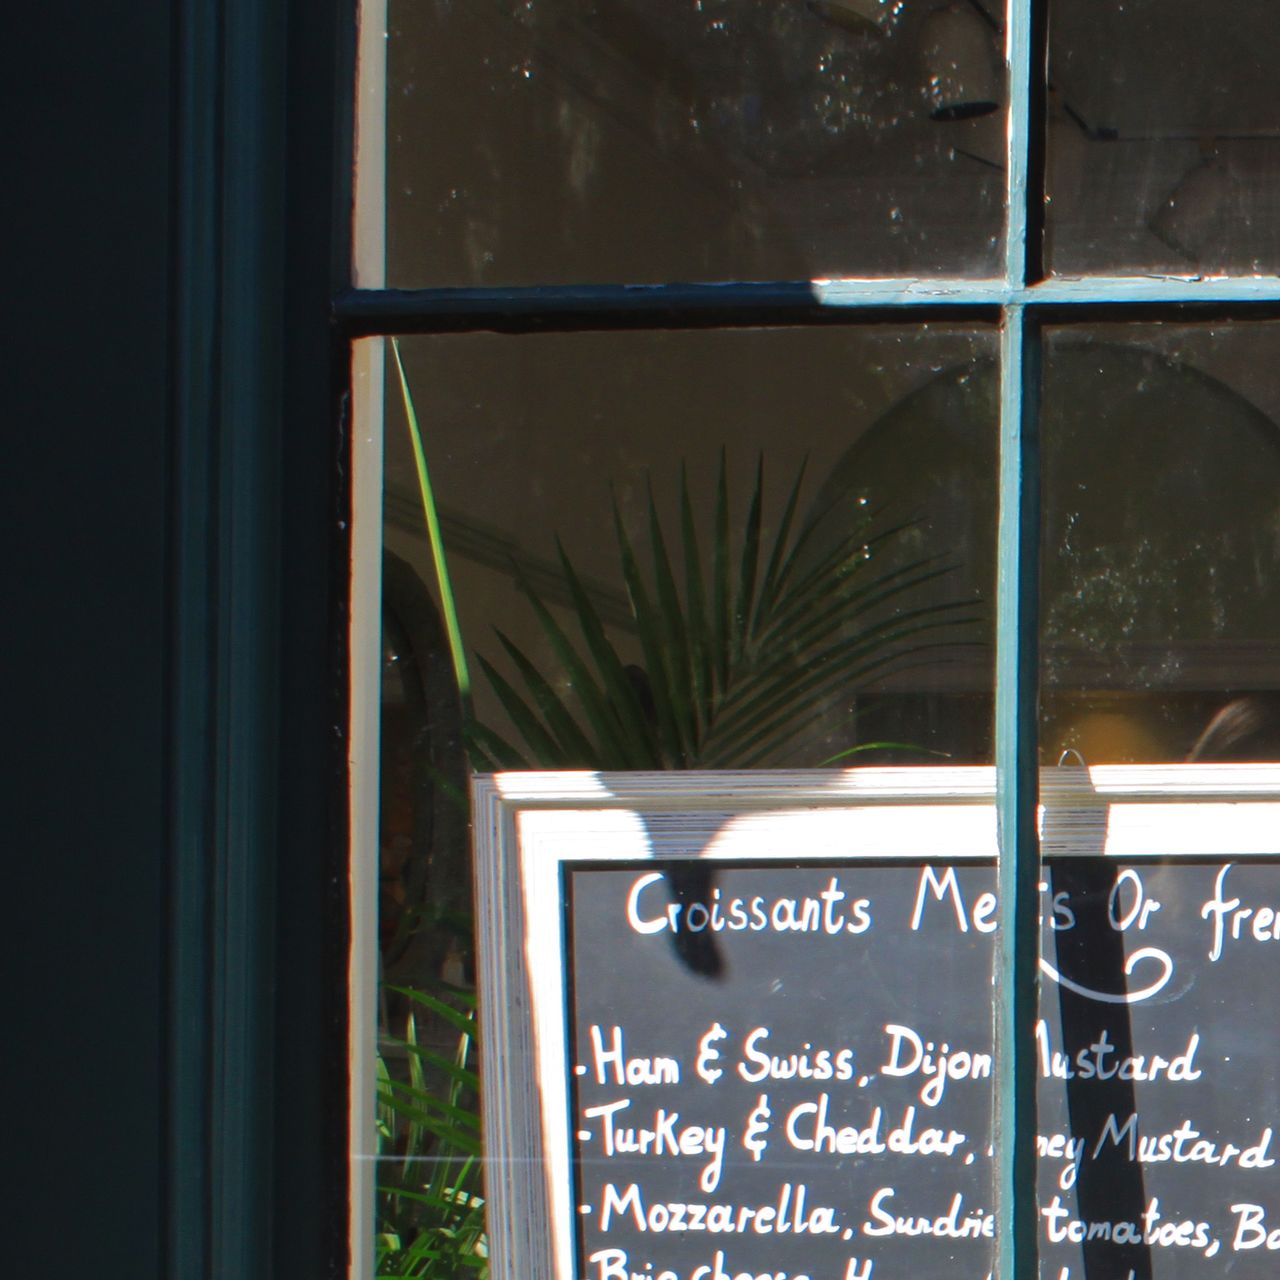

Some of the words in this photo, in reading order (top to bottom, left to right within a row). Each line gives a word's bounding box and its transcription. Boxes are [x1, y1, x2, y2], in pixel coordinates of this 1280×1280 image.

[627, 872, 872, 935] Croissants
[1108, 868, 1161, 931] Or
[695, 1022, 728, 1085] &
[881, 1023, 992, 1107] Dijon
[744, 1094, 771, 1163] &
[1092, 1112, 1276, 1169] Mustard
[862, 1187, 995, 1239] Sundrie
[1040, 1197, 1221, 1258] tomatoes,
